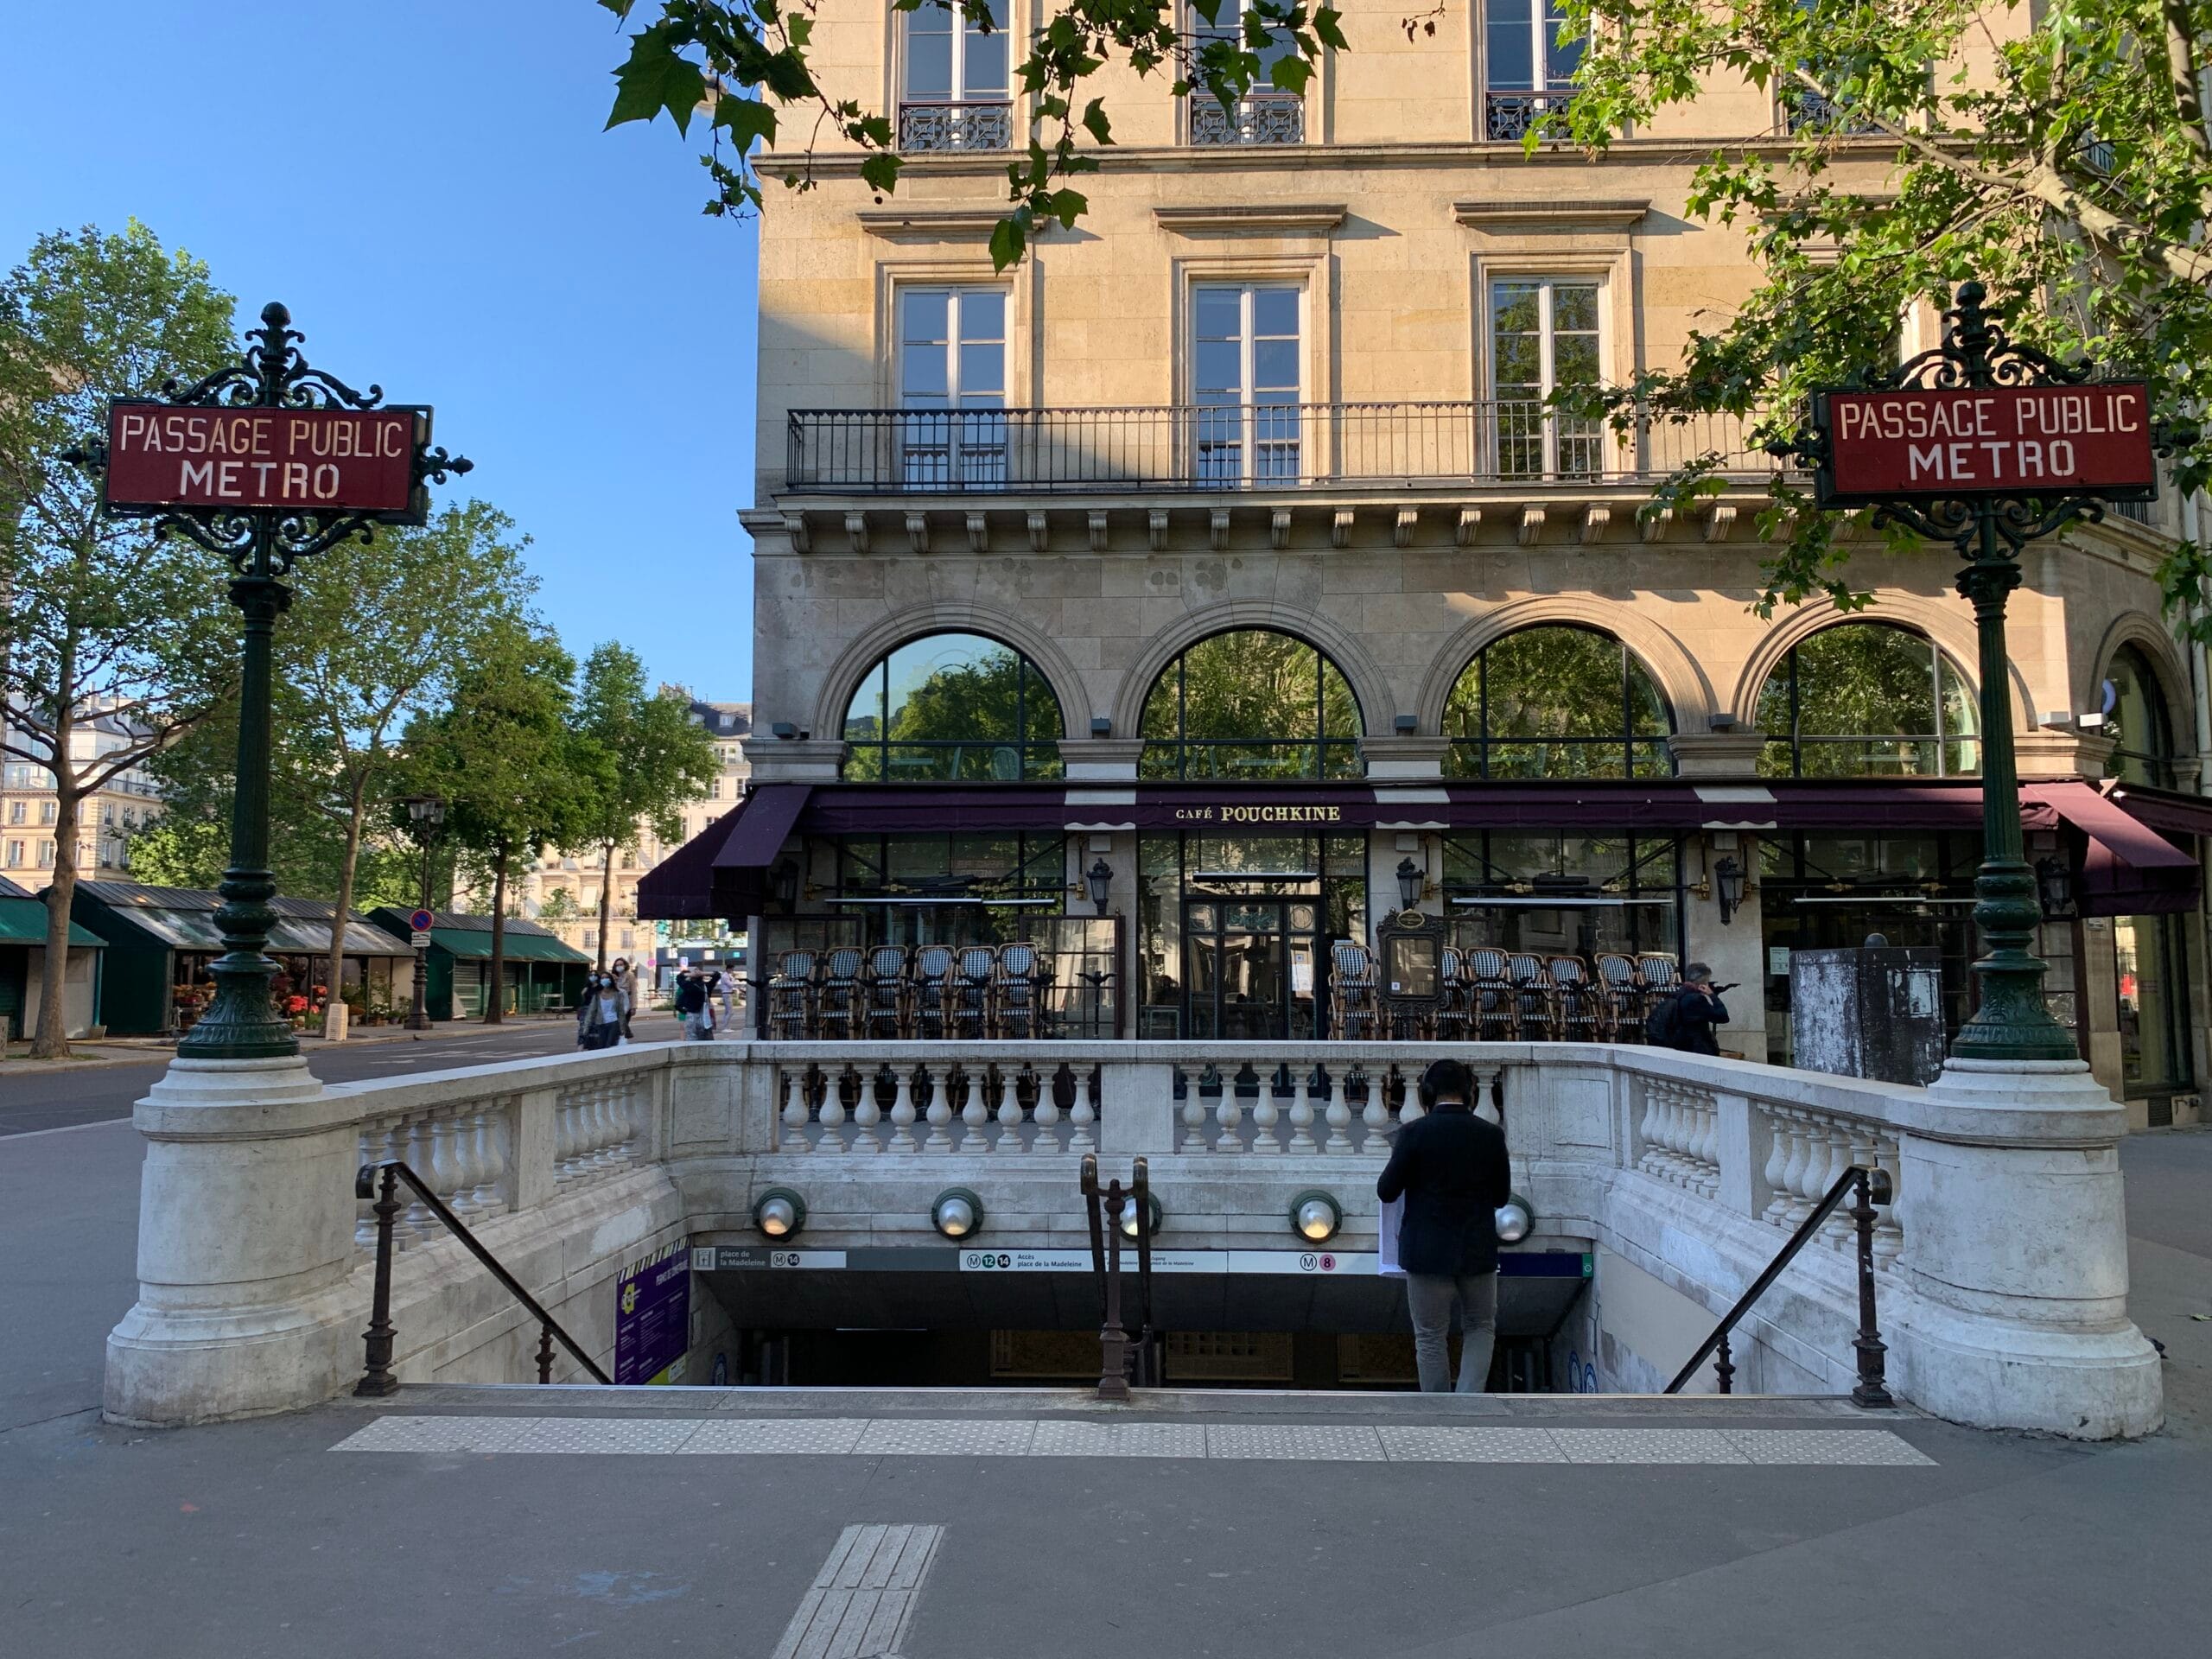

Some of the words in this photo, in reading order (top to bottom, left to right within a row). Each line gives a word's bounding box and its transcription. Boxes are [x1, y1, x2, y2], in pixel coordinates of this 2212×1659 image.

[120, 415, 273, 455] PASSAGE
[289, 419, 404, 458] PUBLIC
[1840, 397, 1997, 440] PASSAGE
[2016, 394, 2139, 435] PUBLIC
[179, 460, 340, 499] METRO
[1908, 439, 2075, 480] METRO
[1175, 806, 1212, 819] CAFÉ
[1221, 806, 1341, 822] POUCHKINE
